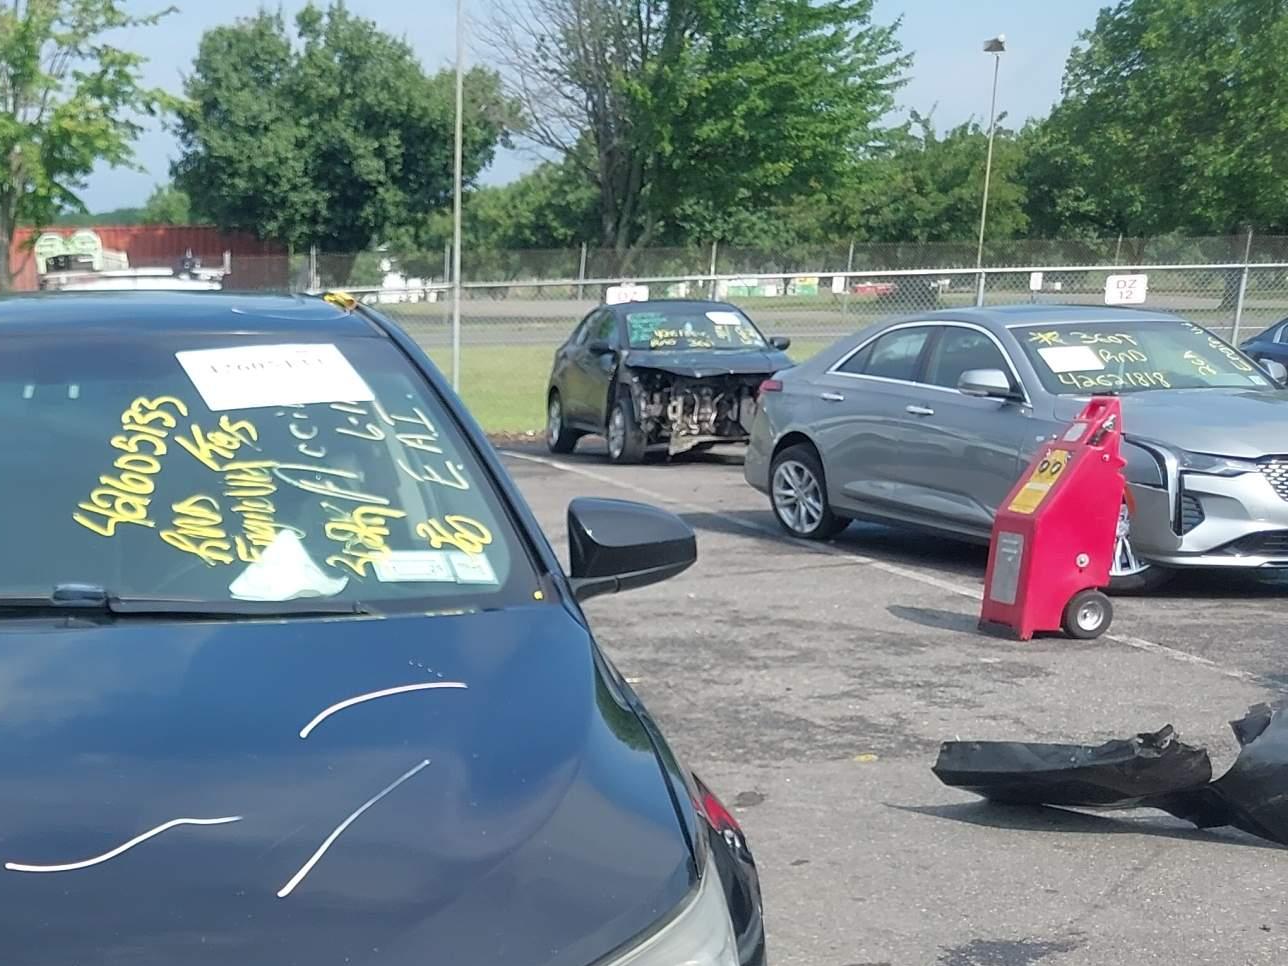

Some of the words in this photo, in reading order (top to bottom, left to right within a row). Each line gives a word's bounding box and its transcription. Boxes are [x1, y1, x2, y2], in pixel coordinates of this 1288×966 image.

[1116, 279, 1137, 289] DZ
[1119, 290, 1133, 299] 12
[1058, 372, 1171, 389] 42621818
[73, 395, 188, 537] 42605133
